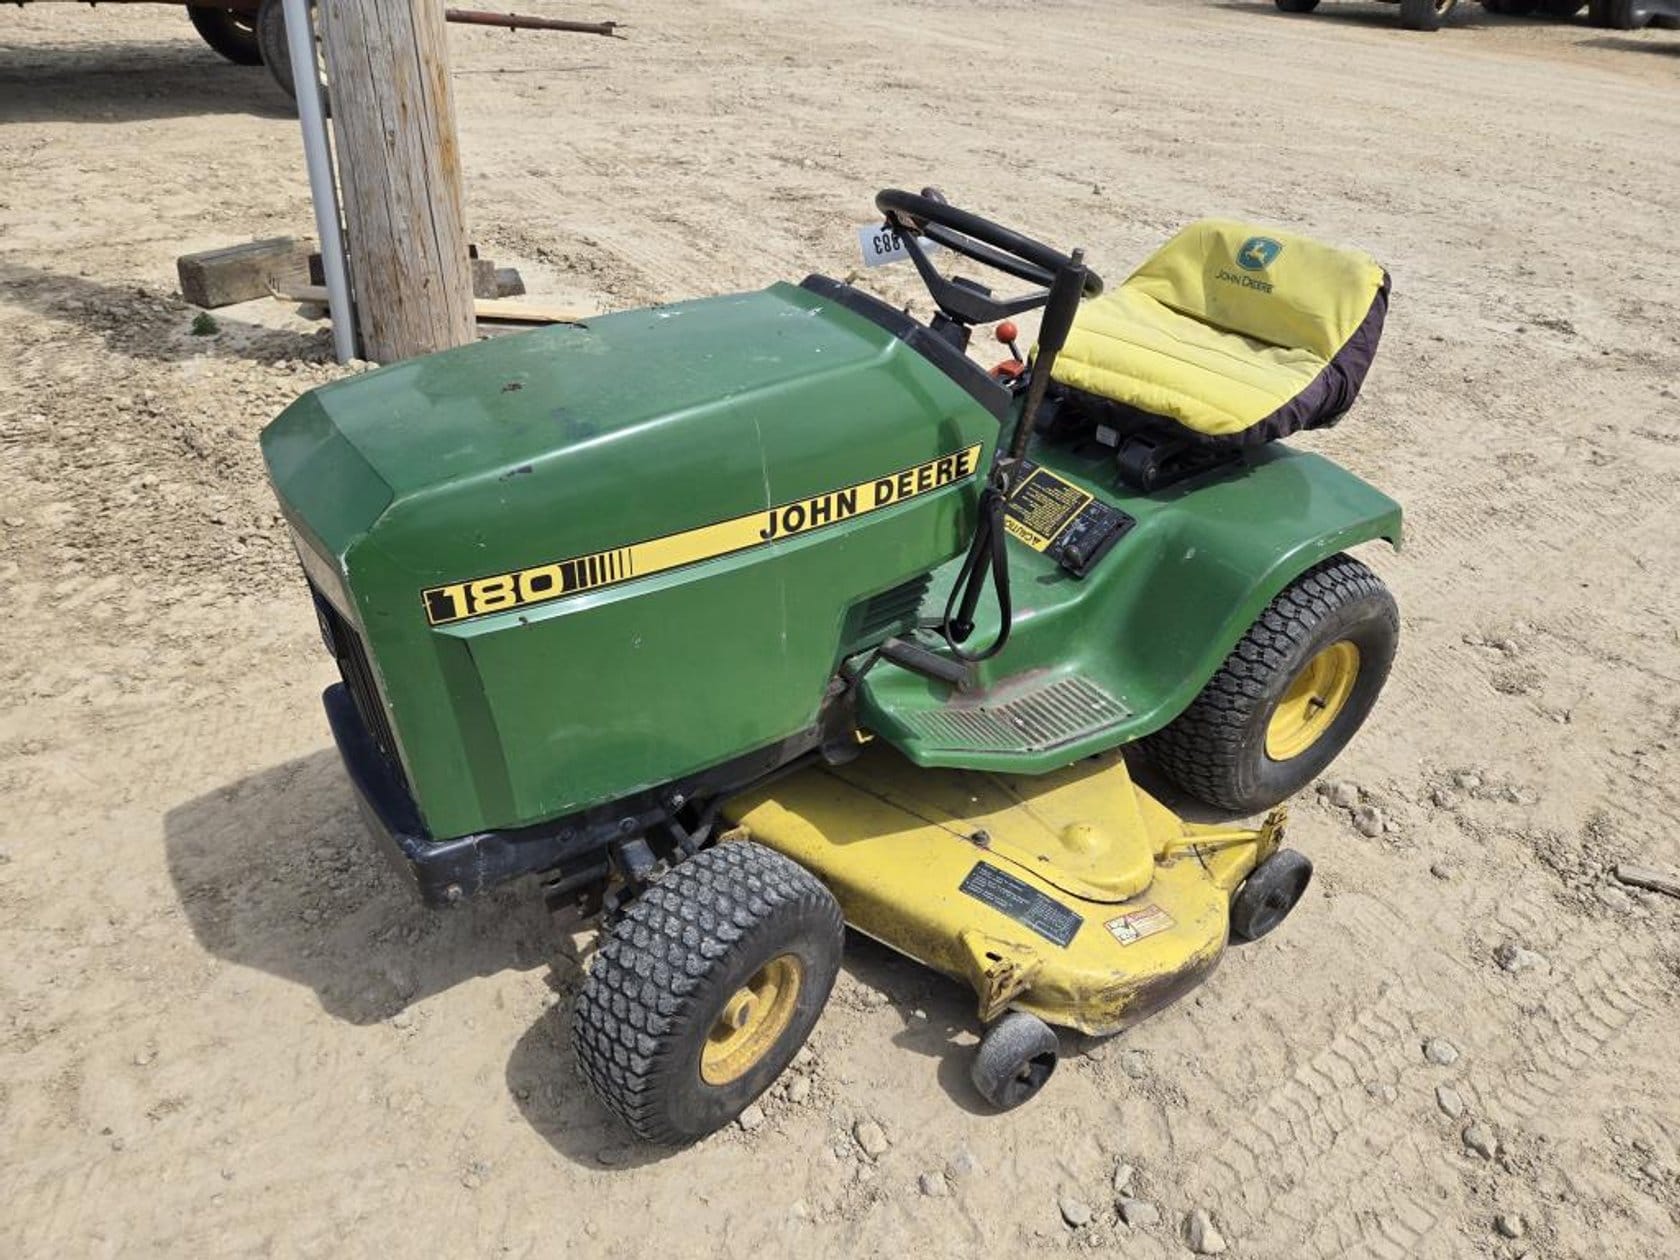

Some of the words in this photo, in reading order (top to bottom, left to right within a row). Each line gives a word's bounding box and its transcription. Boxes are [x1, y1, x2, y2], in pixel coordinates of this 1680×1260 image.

[1214, 269, 1241, 285] JOHN
[1241, 275, 1274, 294] DEERE
[759, 489, 858, 540] JOHN
[874, 450, 971, 506] DEERE
[1005, 518, 1034, 542] CAUTI
[442, 563, 564, 618] 180
